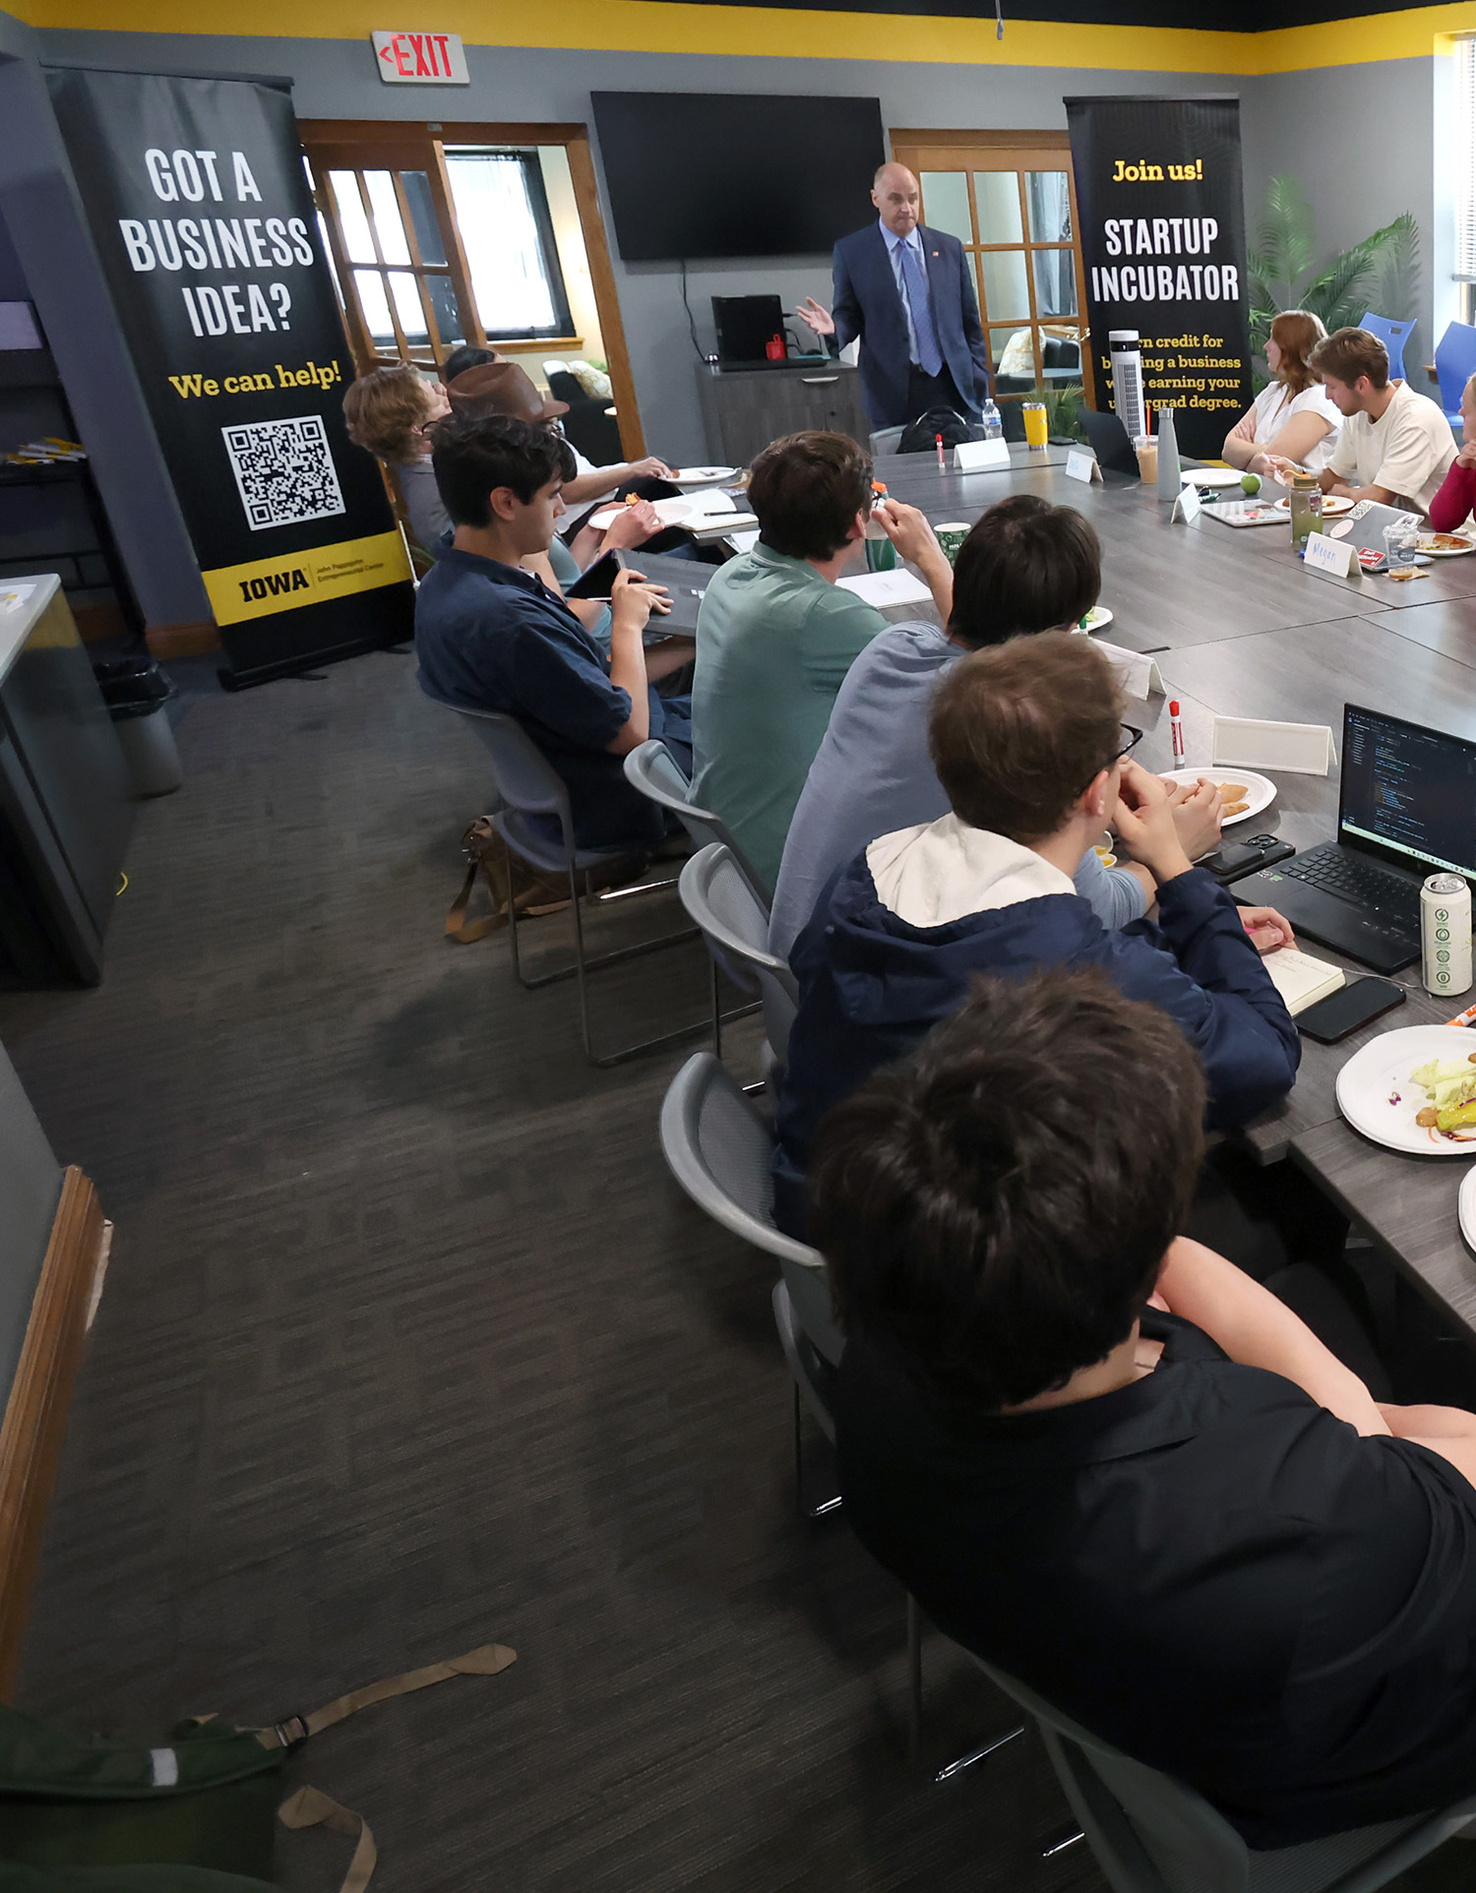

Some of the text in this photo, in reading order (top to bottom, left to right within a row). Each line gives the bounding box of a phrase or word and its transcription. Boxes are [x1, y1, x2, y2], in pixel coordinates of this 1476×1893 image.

[390, 34, 452, 77] EXIT
[145, 149, 263, 202] GOT A
[1112, 159, 1204, 182] Join us!
[118, 217, 315, 272] BUSINESS
[1104, 217, 1219, 256] STARTUP
[1091, 264, 1240, 302] INCUBATOR
[181, 282, 293, 337] IDEA?
[1155, 334, 1200, 349] credit
[1202, 334, 1224, 348] for
[168, 360, 343, 399] We can help!
[1101, 354, 1242, 372] bing a business
[1148, 375, 1206, 391] earning
[1207, 379, 1241, 392] your
[1108, 395, 1242, 412] urgrad degree.
[1313, 542, 1337, 566] Megan
[238, 568, 310, 603] IOWA
